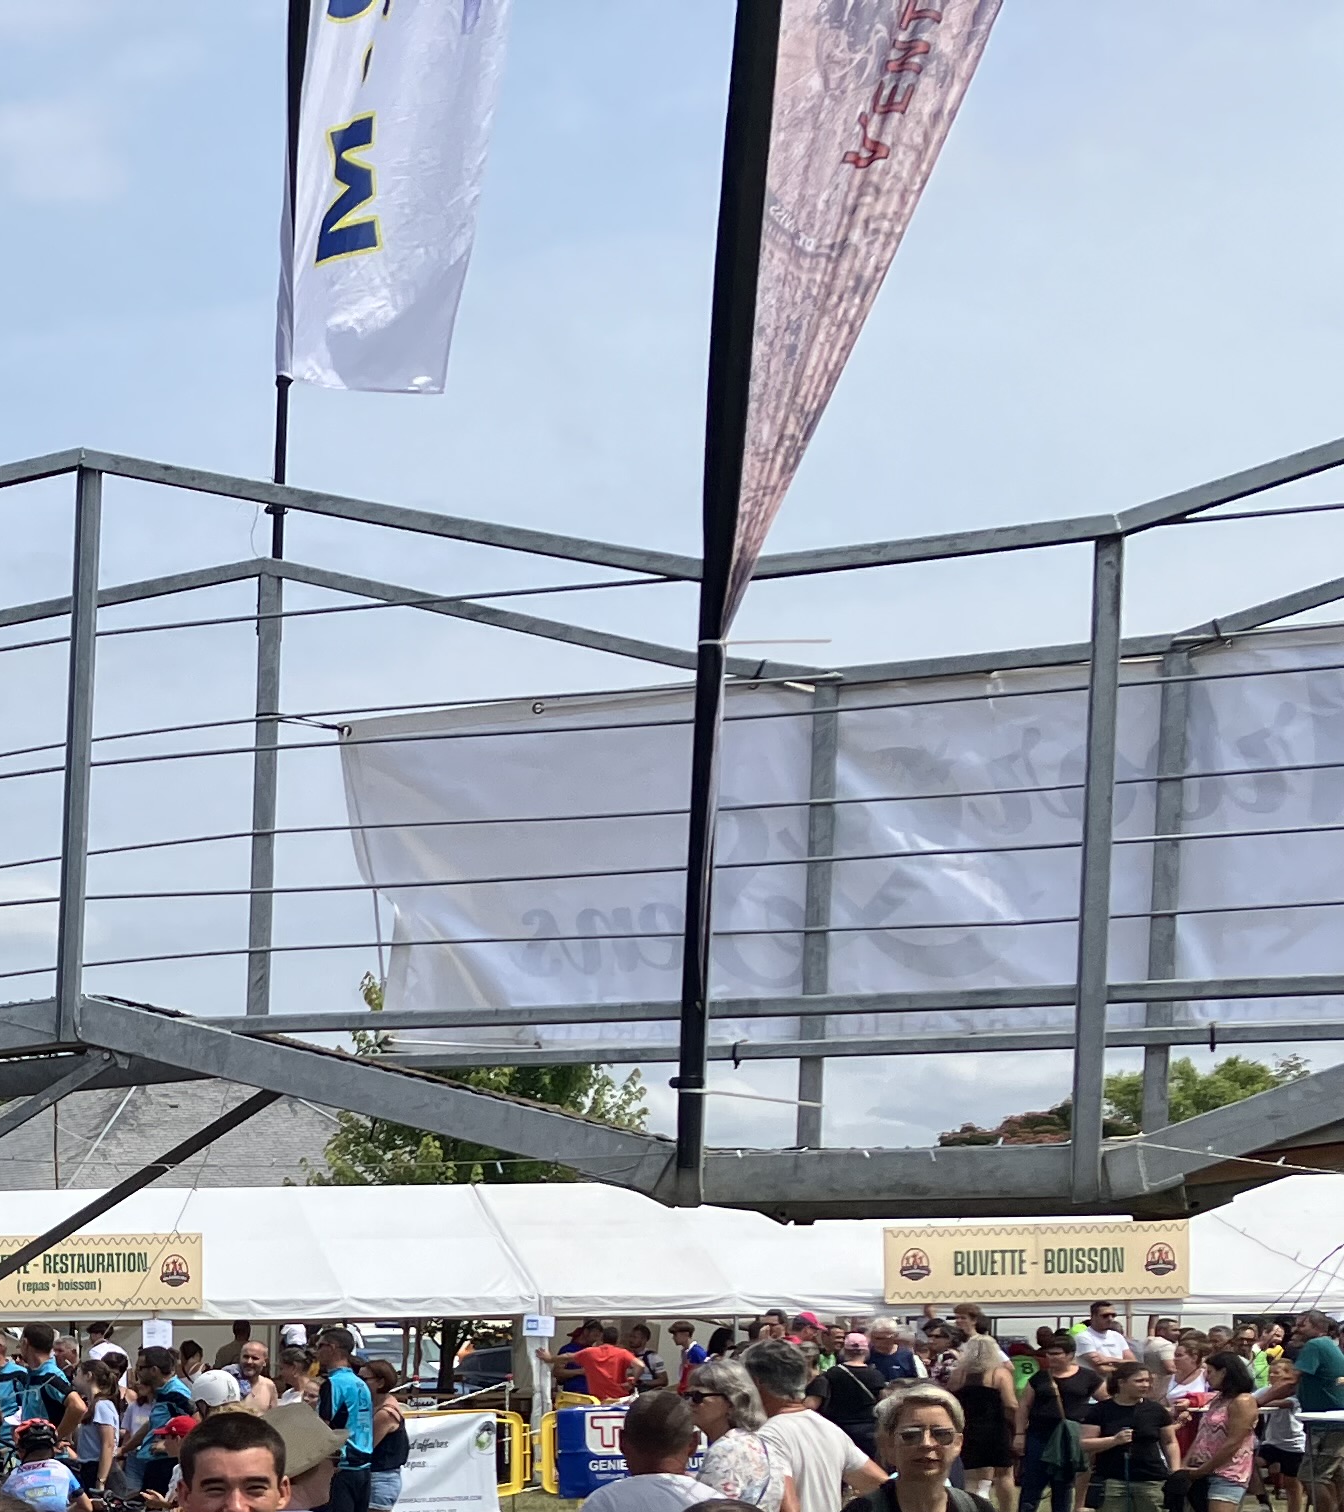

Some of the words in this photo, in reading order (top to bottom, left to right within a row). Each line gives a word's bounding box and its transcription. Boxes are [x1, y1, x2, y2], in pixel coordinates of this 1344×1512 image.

[43, 1252, 148, 1274] RESTAURATION
[954, 1249, 1027, 1276] BUVETTE
[1044, 1247, 1124, 1274] BOISSON
